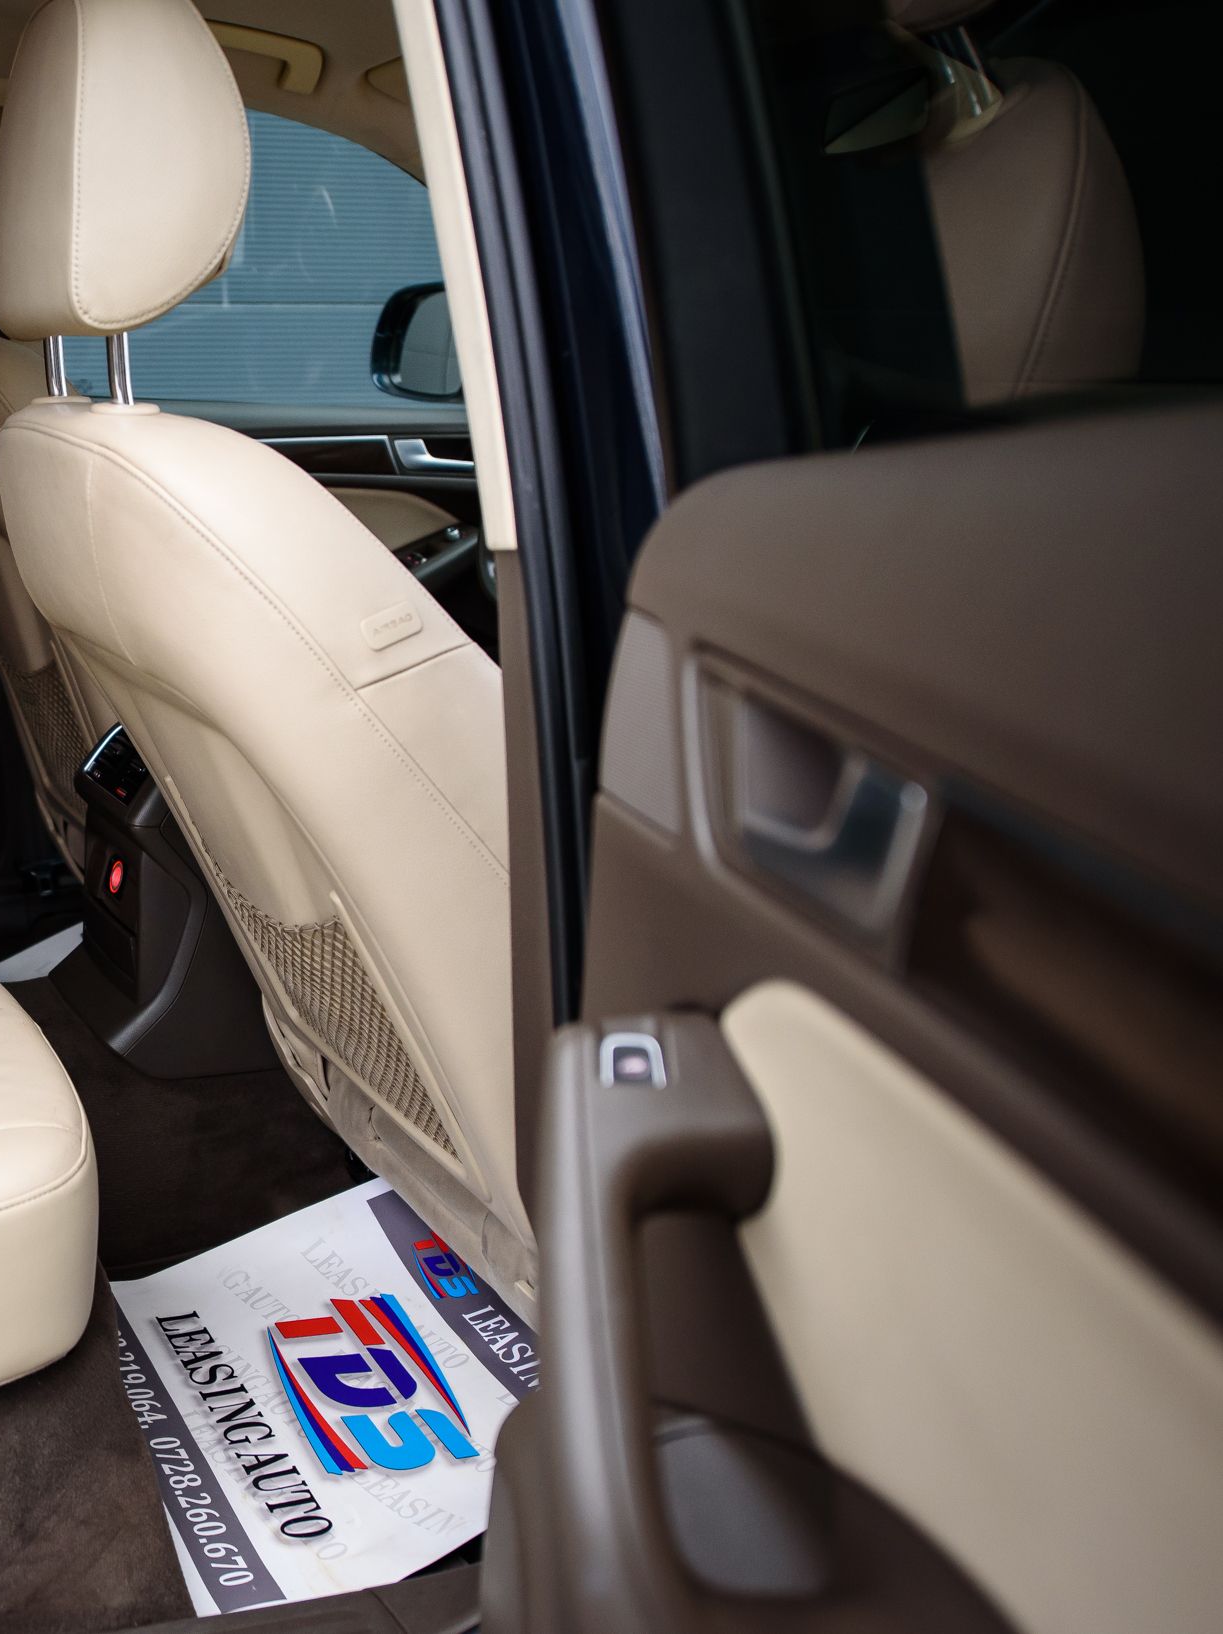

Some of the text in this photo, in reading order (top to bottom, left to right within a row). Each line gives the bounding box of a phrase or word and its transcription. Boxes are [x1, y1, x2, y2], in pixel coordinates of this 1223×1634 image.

[149, 1436, 254, 1587] 0728.260.670
[155, 1309, 274, 1449] LEASING
[235, 1449, 334, 1539] AUTO
